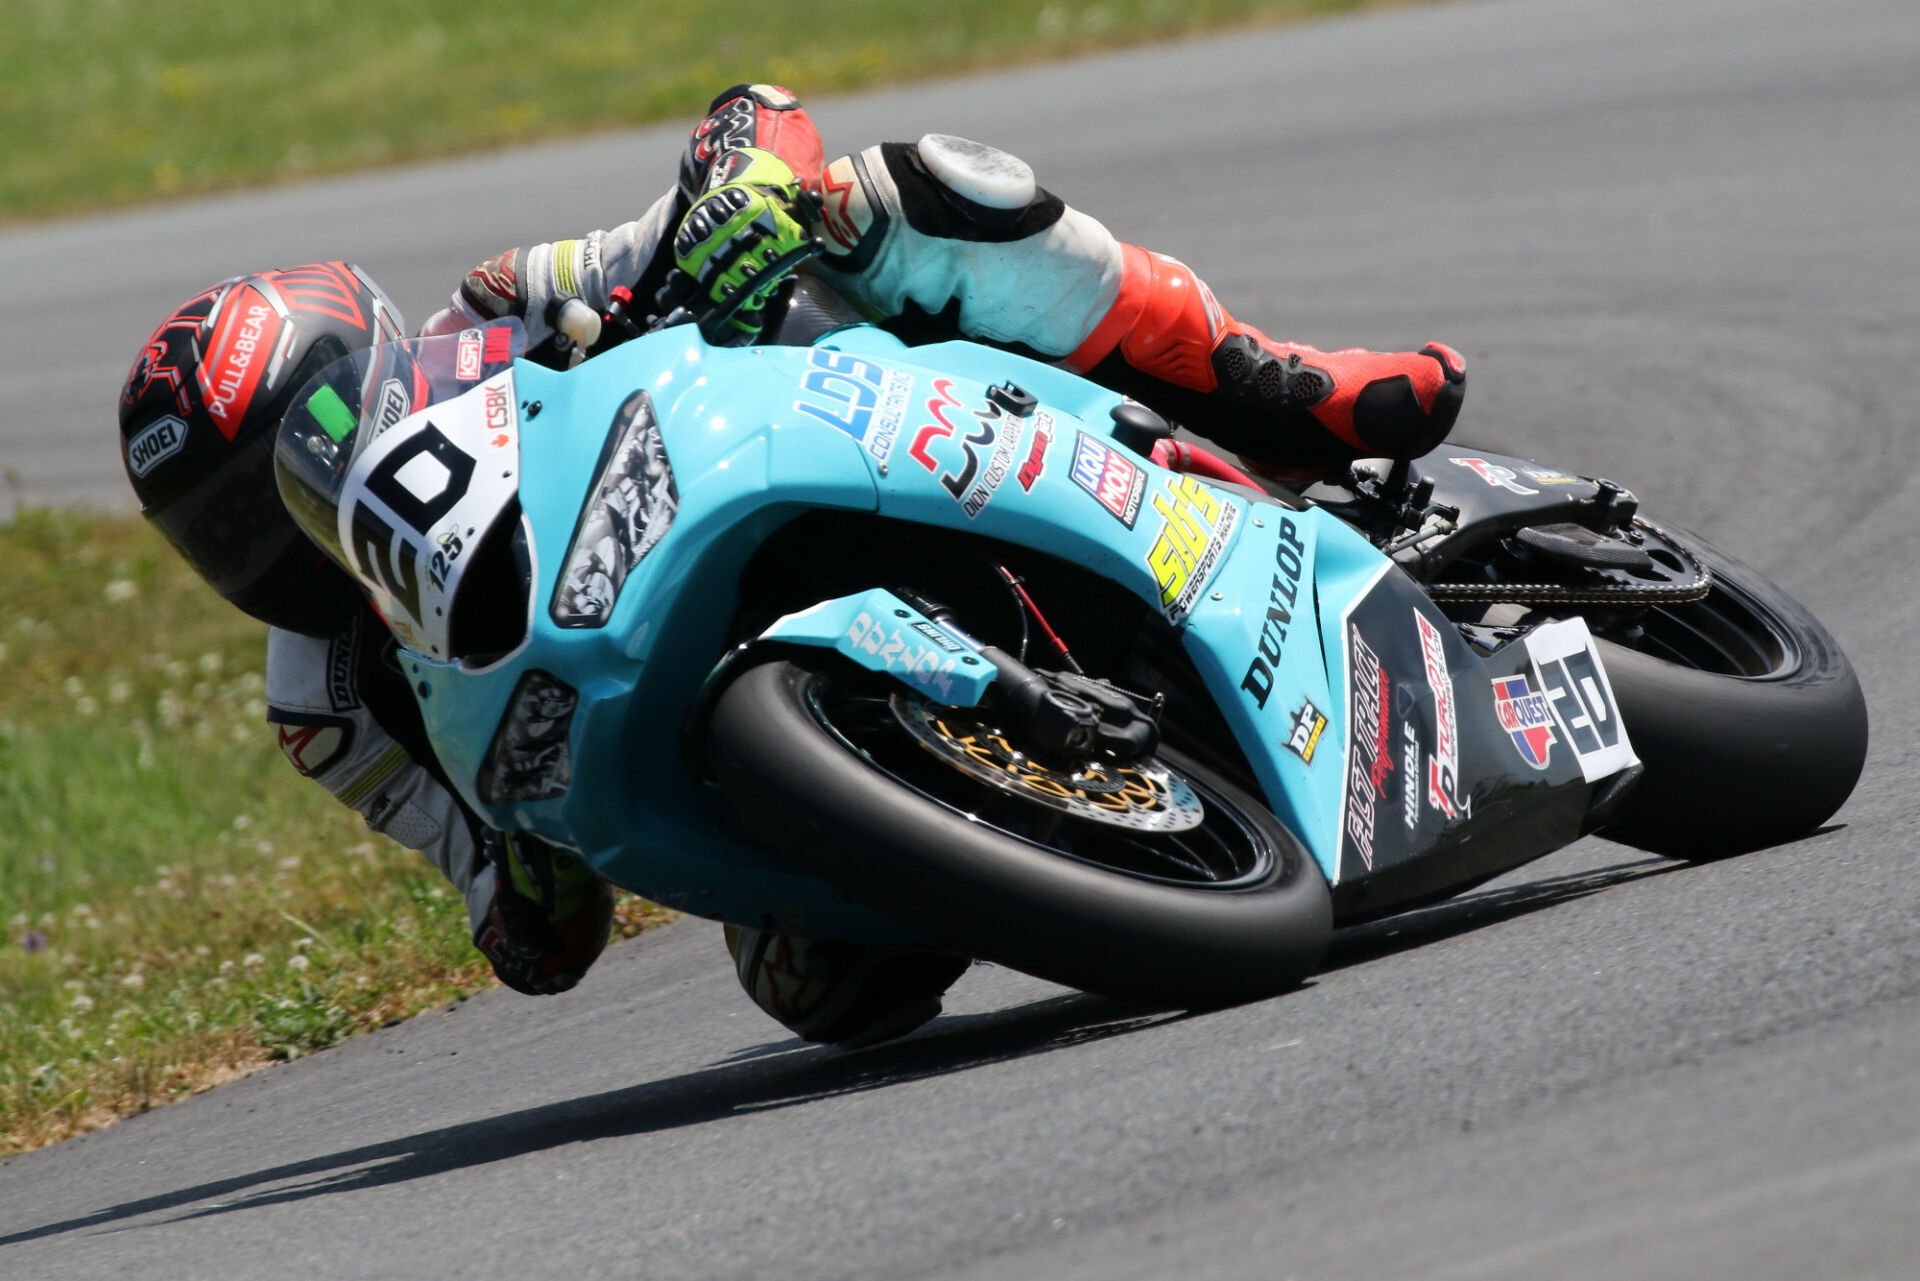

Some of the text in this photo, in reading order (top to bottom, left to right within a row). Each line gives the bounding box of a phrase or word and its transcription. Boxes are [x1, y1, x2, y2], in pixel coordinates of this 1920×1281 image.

[208, 305, 270, 418] PULL&BEAR
[459, 344, 480, 377] KSR
[485, 383, 508, 429] CSBK
[798, 349, 884, 442] LDS
[132, 423, 177, 469] SHOEI
[1075, 438, 1106, 491] LIQUI
[963, 484, 989, 517] DION
[984, 443, 1013, 489] CUSTOM
[1100, 455, 1136, 515] MOLY
[1124, 472, 1147, 525] MOTORBIKE
[429, 534, 463, 593] 125
[1240, 516, 1305, 710] DUNLOP
[845, 613, 956, 698] DUNLOP
[1418, 614, 1451, 758] TURCOTTE
[1498, 695, 1551, 729] CARQUEST
[1404, 721, 1415, 830] HINDLE
